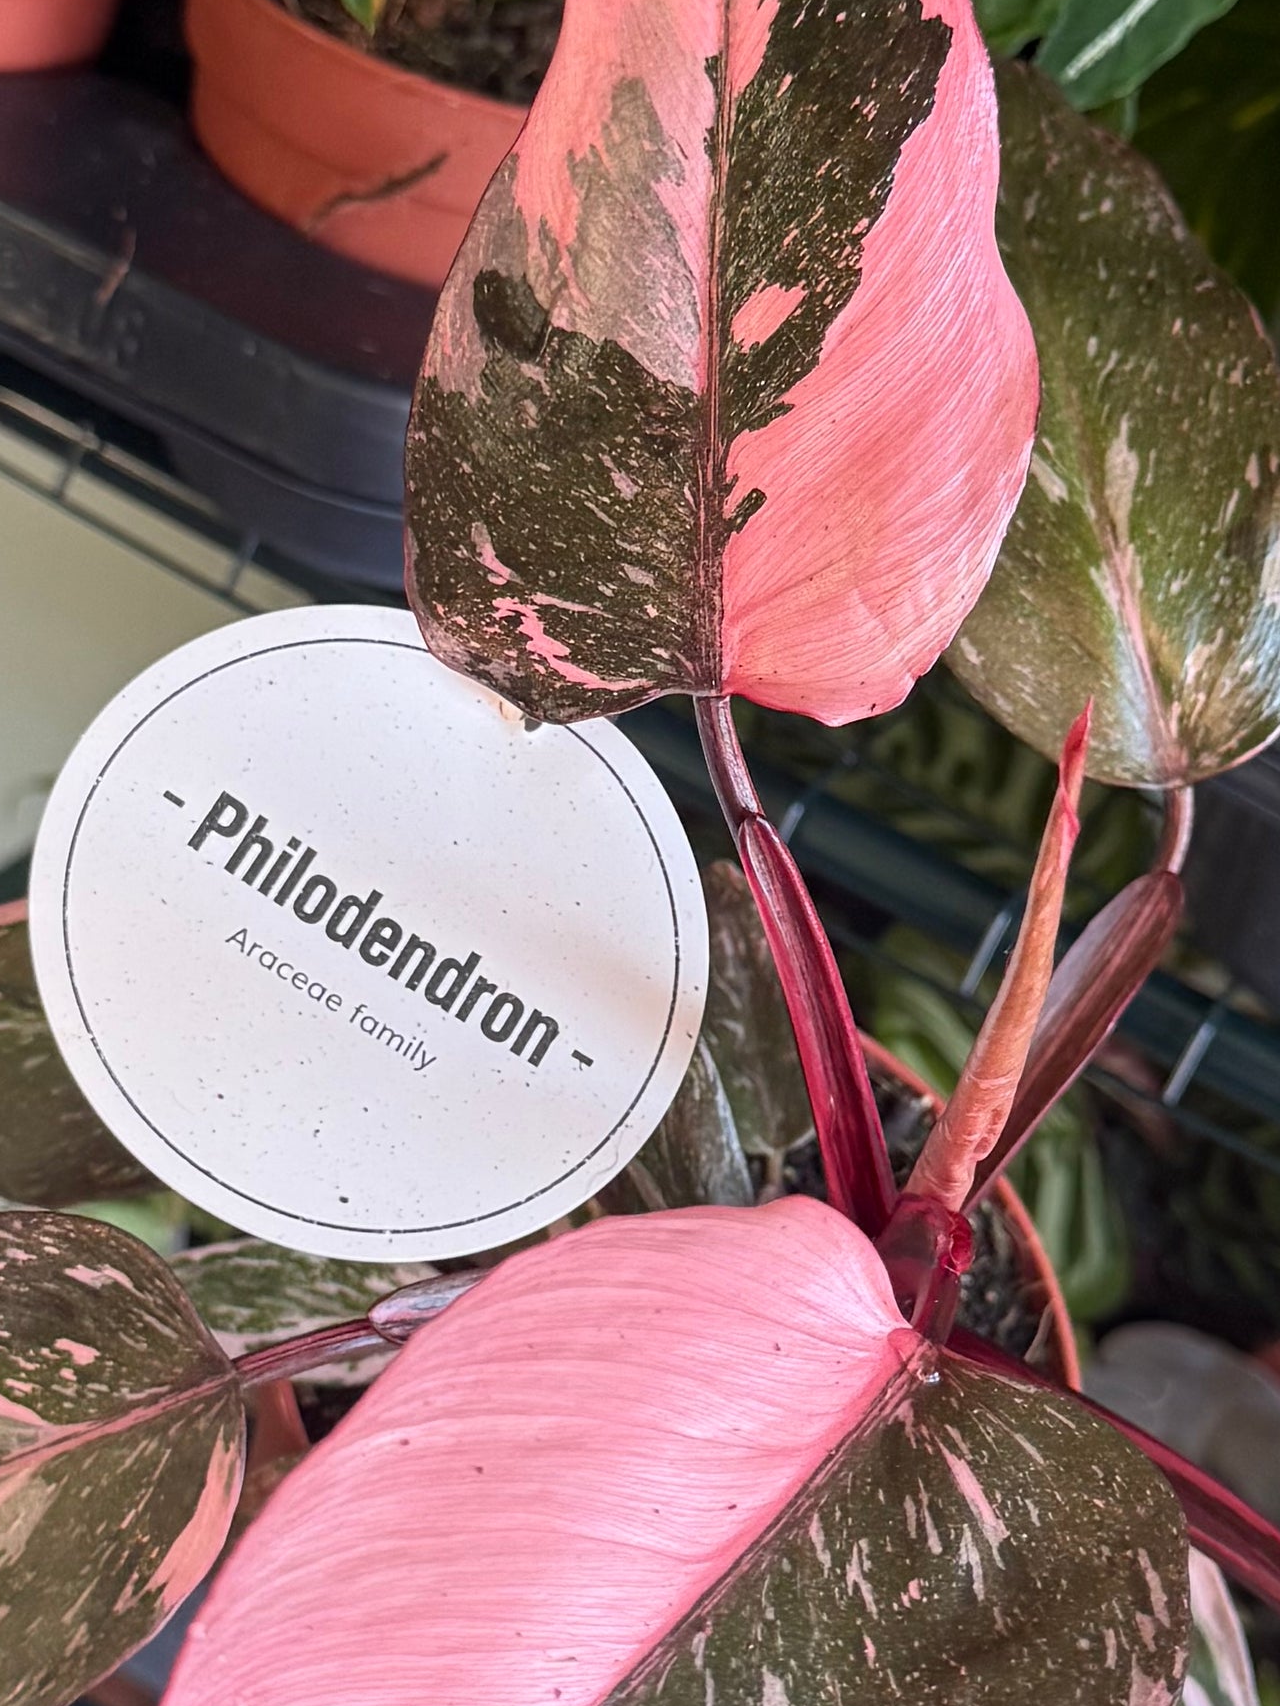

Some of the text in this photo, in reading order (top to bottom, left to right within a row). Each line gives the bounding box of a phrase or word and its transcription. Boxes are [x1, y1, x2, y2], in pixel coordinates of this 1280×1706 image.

[186, 790, 561, 1068] Philodendron
[224, 926, 438, 1072] Araceae family
